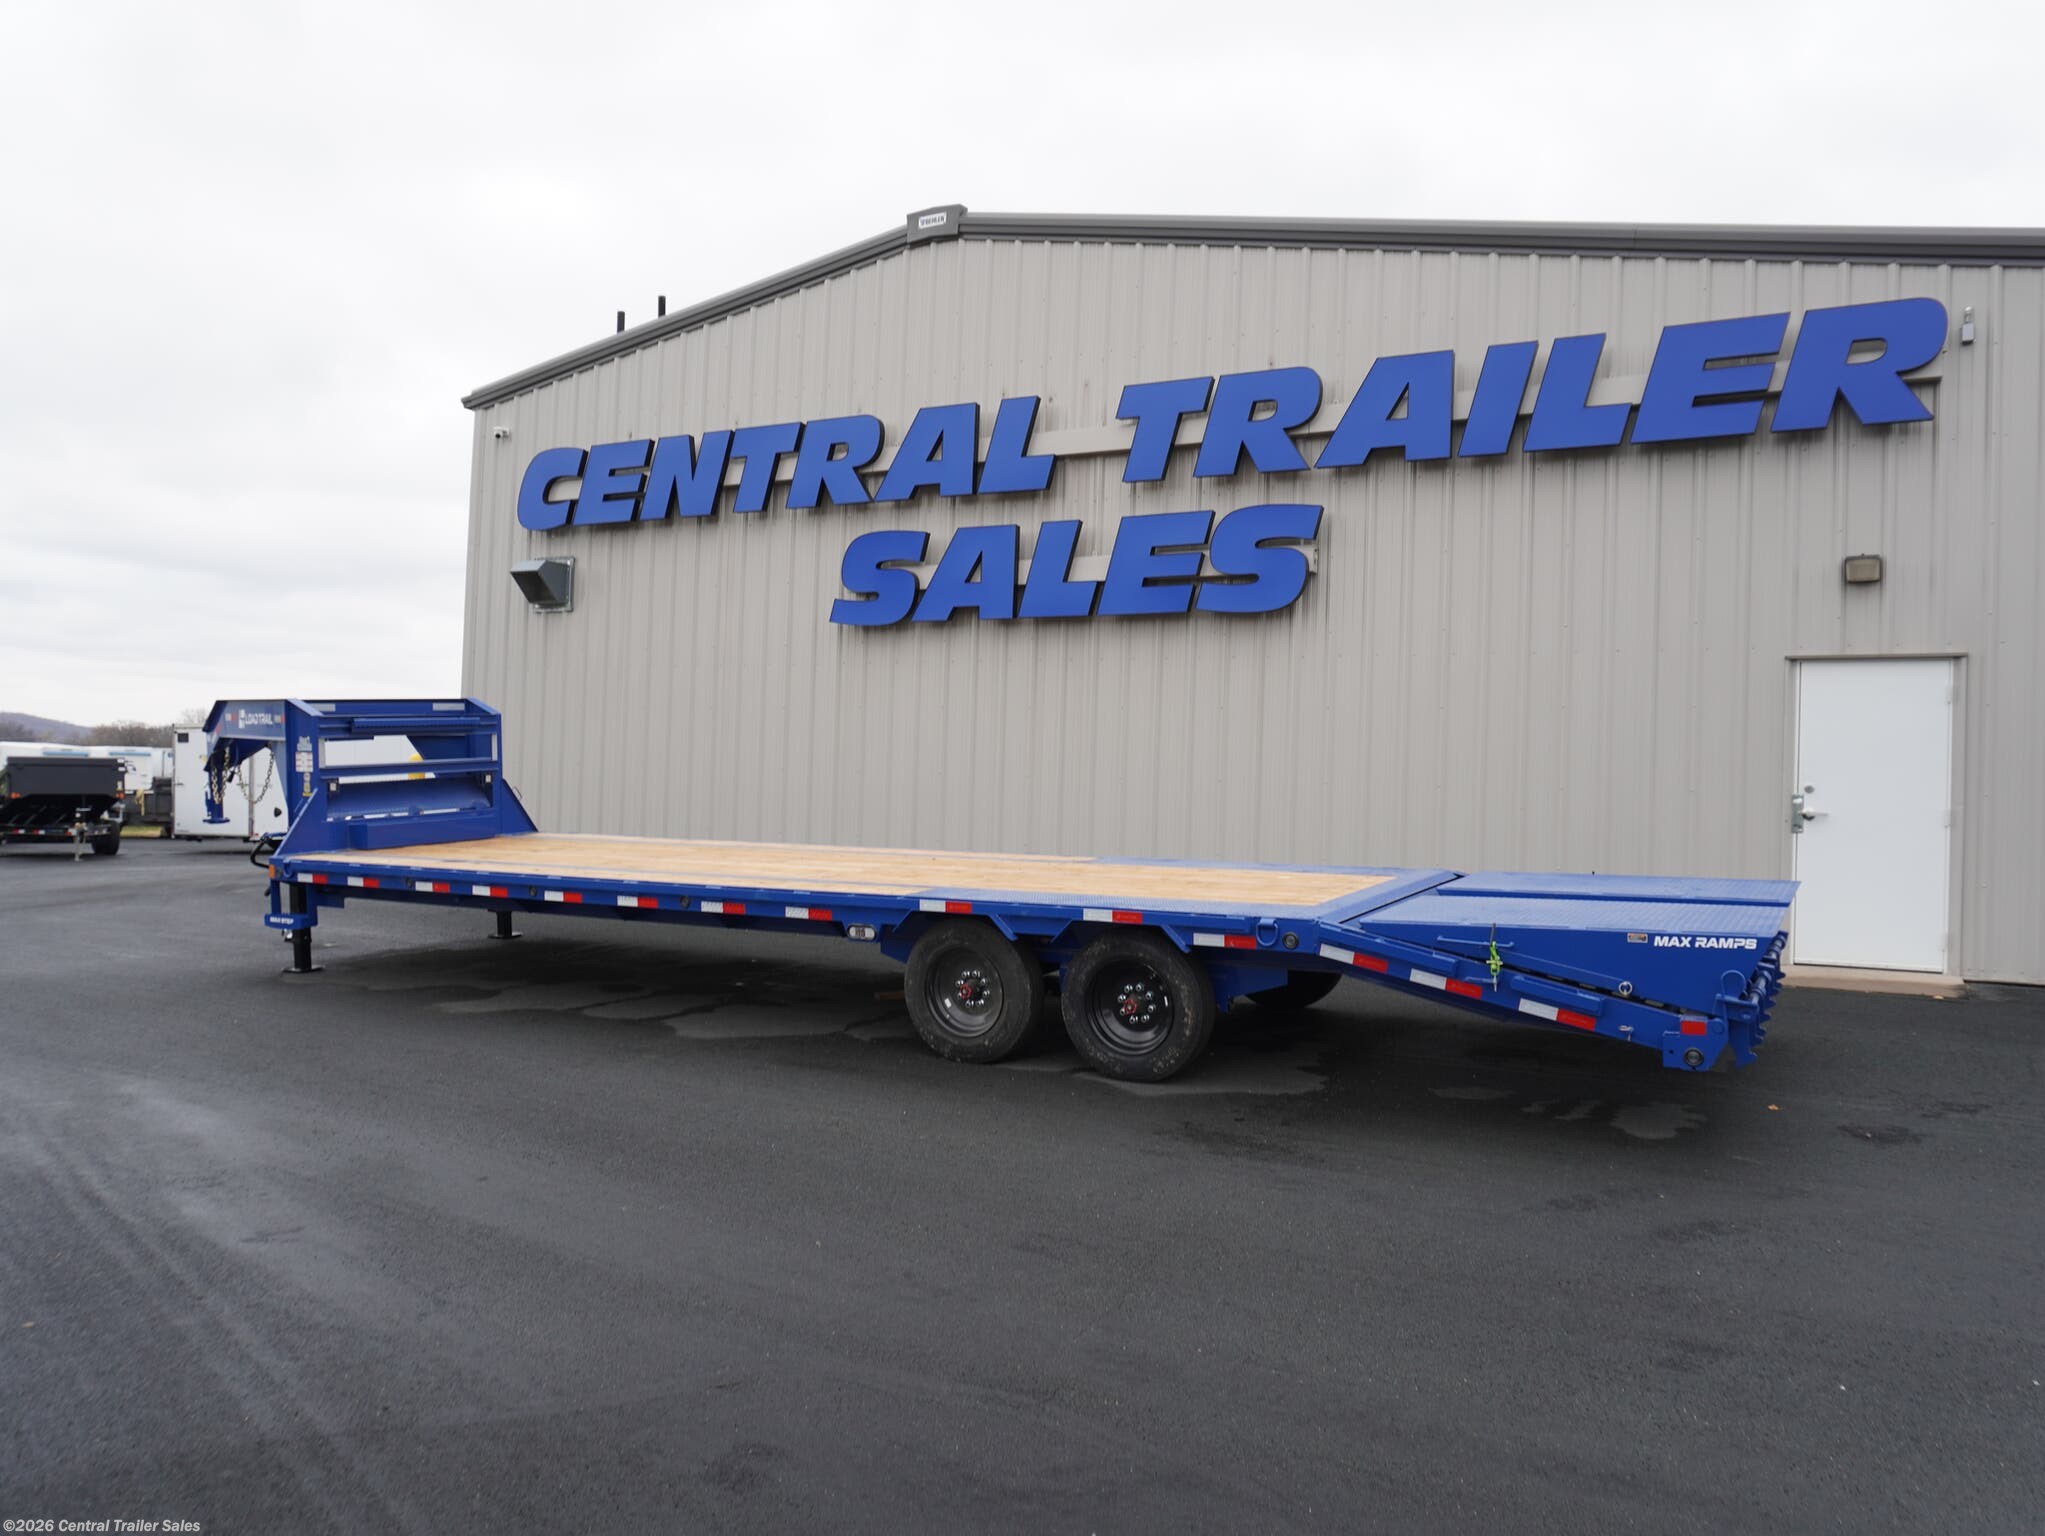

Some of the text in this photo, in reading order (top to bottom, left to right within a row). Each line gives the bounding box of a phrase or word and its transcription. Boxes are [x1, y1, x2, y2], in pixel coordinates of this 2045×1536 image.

[517, 297, 1949, 531] CENTRAL TRAILER
[829, 504, 1324, 627] SALES
[1654, 935, 1691, 947] MAX
[1695, 937, 1757, 949] RAMPS
